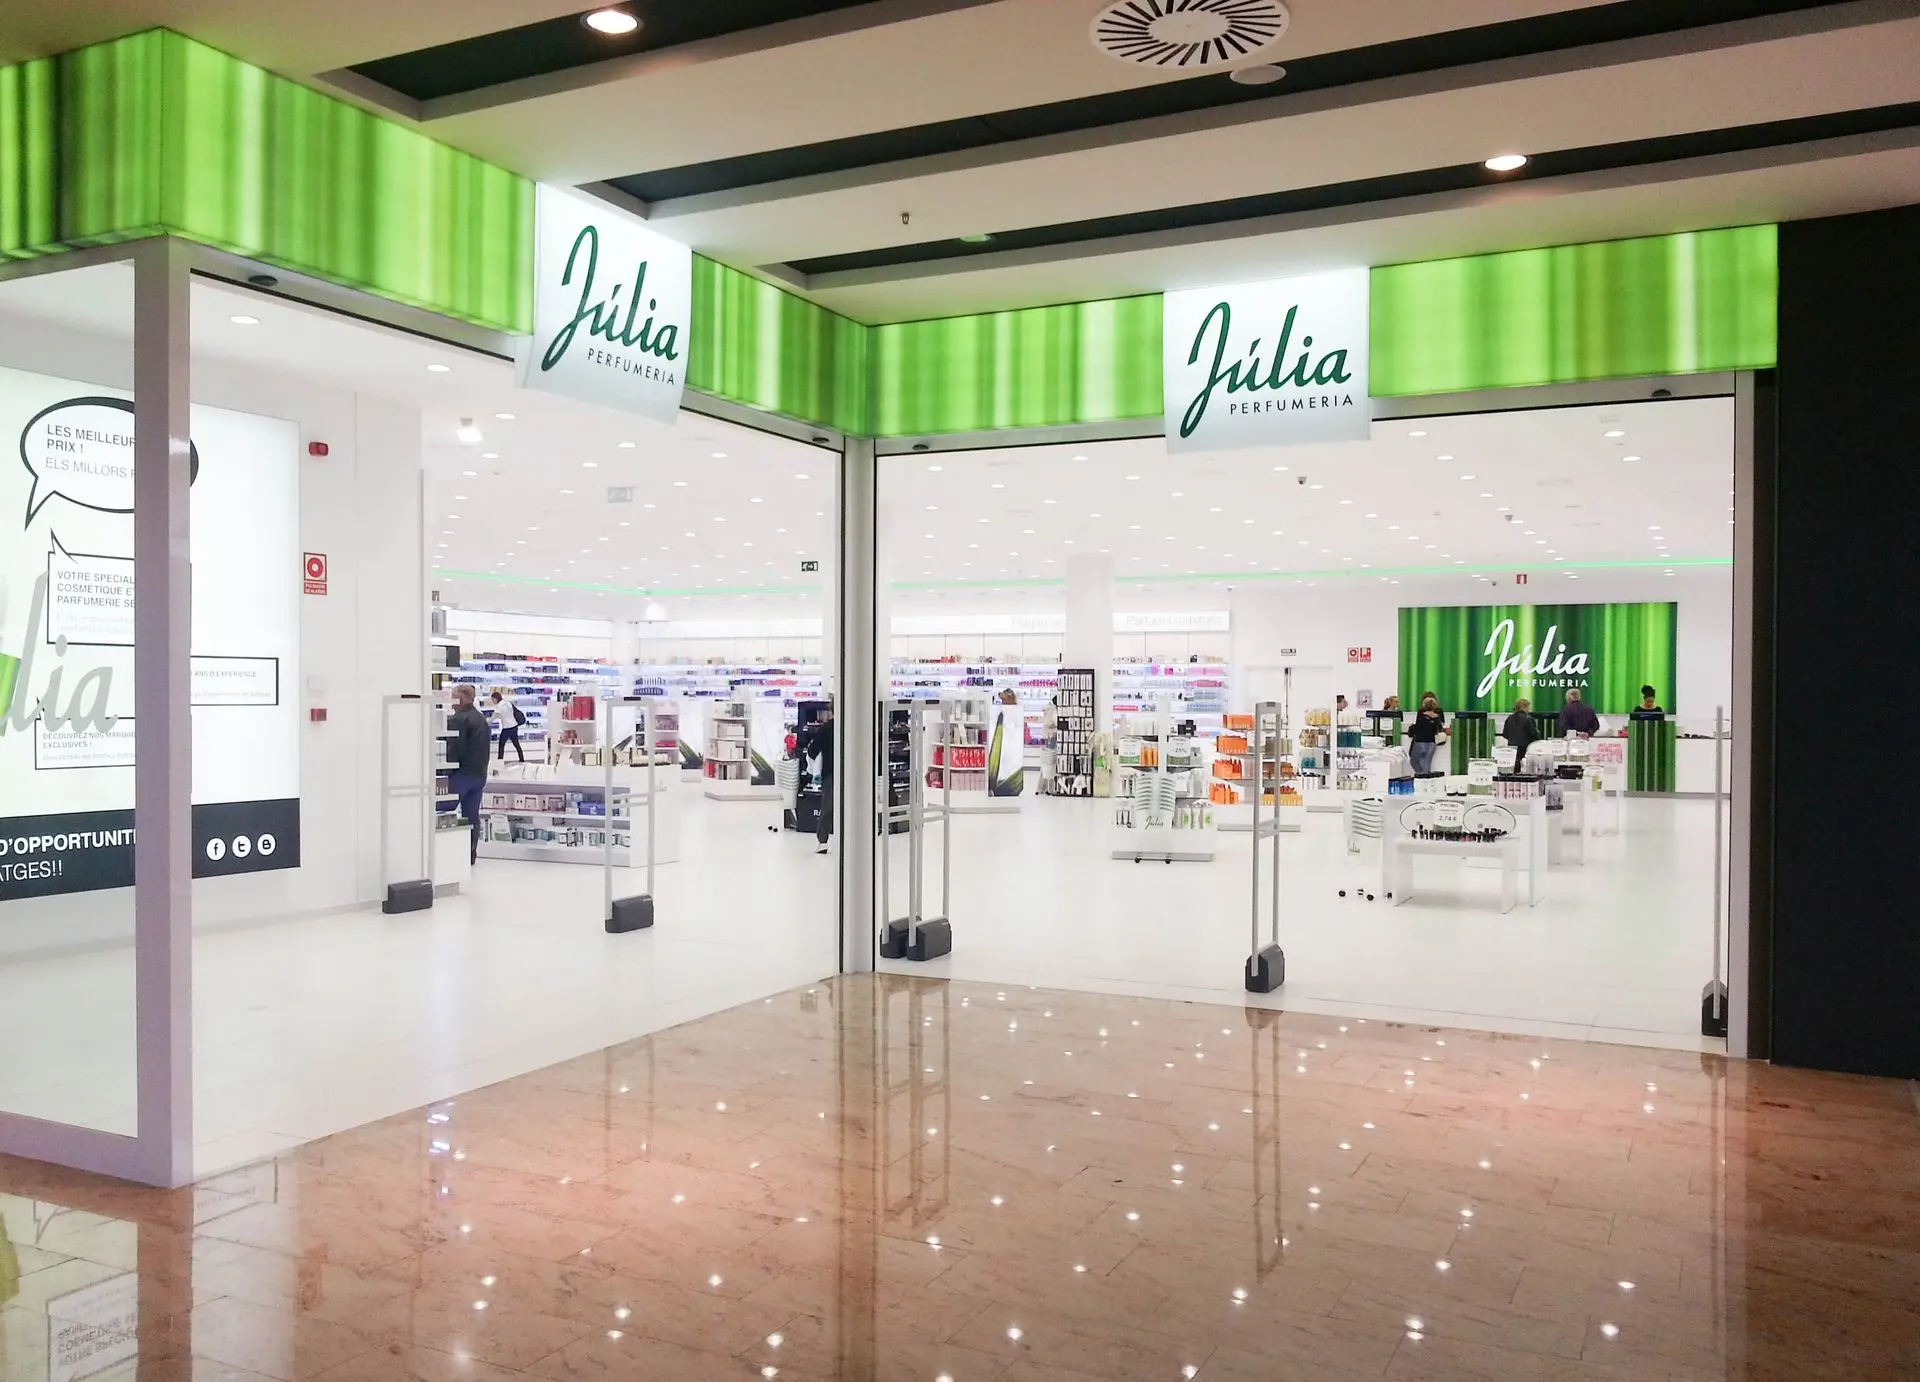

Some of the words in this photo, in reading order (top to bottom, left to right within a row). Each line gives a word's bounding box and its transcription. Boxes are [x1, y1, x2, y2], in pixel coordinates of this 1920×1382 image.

[541, 225, 679, 372] Júlia
[587, 348, 675, 386] PERFUMERIA
[1180, 301, 1352, 438] Júlia
[1230, 394, 1353, 415] PERFUMERIA
[47, 424, 71, 438] LES
[47, 439, 76, 453] PRIX
[80, 444, 84, 454] !
[45, 456, 69, 471] ELS
[73, 461, 127, 478] MILLORS
[57, 571, 91, 581] VOTRE
[57, 583, 123, 595] COSMETIQUE
[57, 595, 121, 607] PARFUMERIE
[1476, 618, 1590, 698] Júlia
